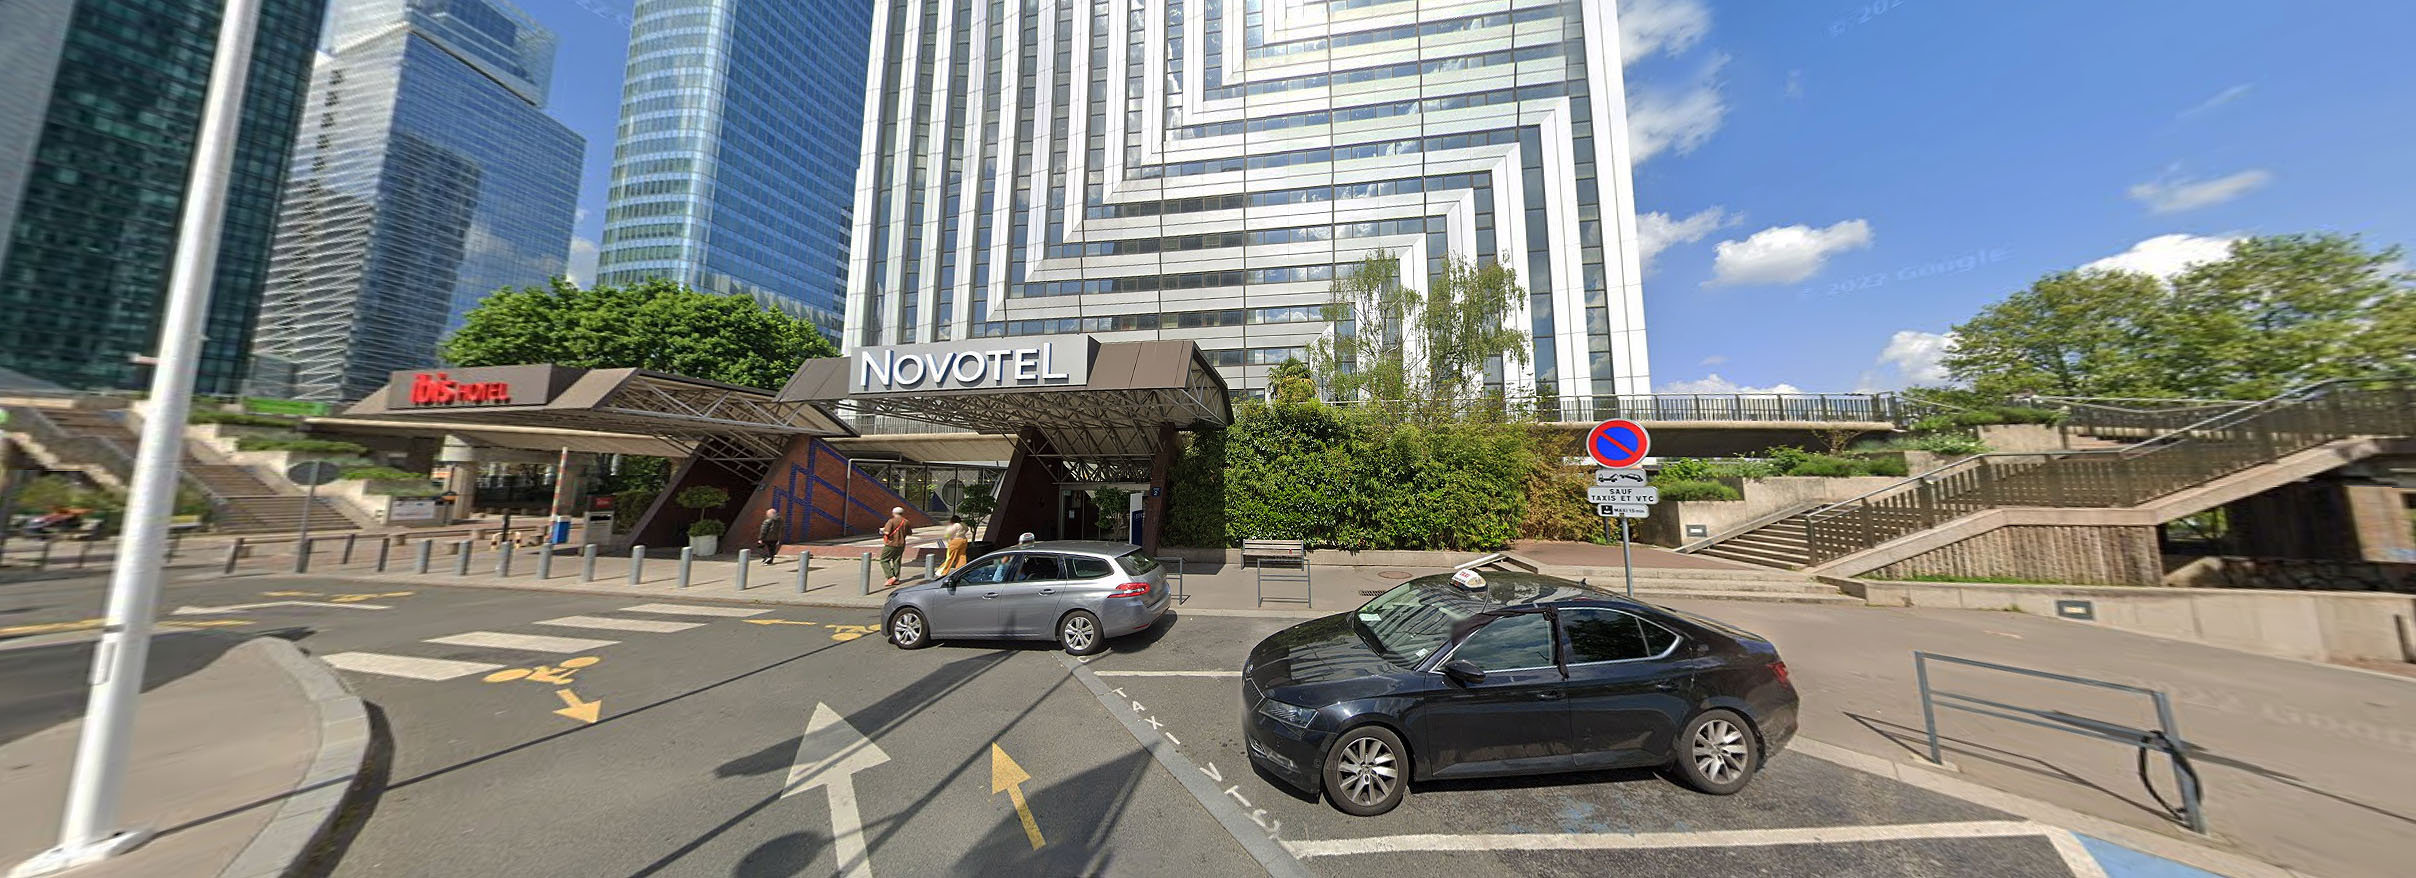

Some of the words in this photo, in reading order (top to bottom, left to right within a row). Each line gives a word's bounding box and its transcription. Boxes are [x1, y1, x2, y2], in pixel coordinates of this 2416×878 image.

[860, 341, 1069, 387] NOVOTEL
[458, 381, 510, 403] HOTEL
[1112, 687, 1181, 745] TAXI
[1199, 761, 1281, 834] VTC
